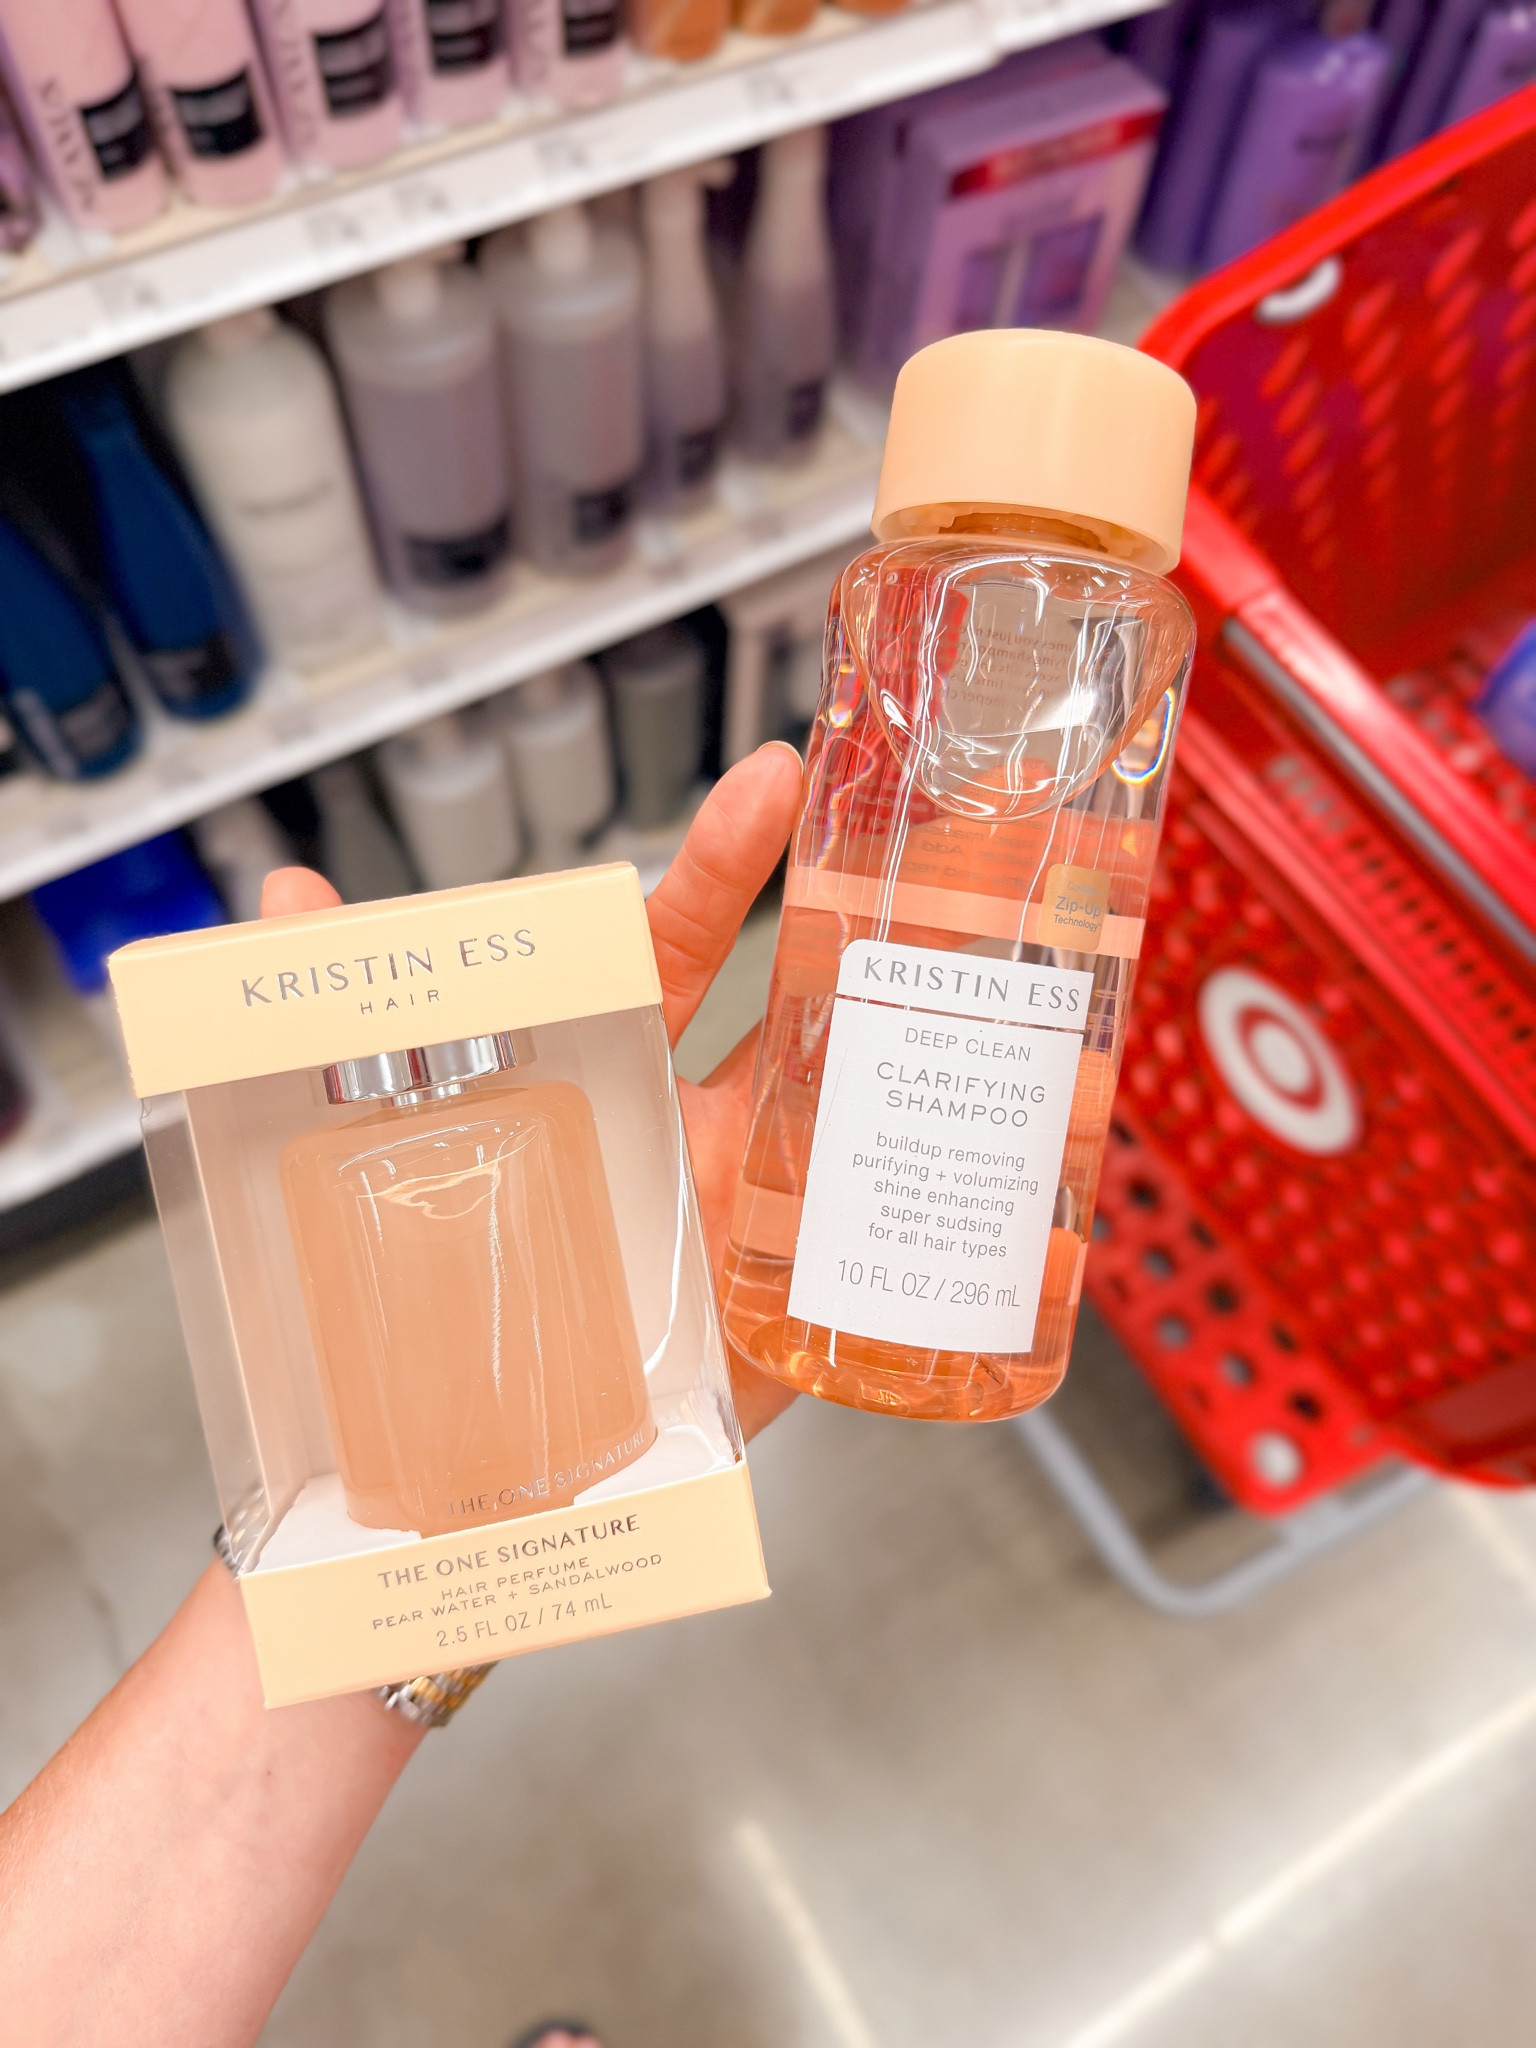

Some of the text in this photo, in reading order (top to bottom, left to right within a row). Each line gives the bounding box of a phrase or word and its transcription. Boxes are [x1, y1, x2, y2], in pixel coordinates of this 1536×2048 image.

[1055, 895, 1101, 920] Zip-Up
[240, 928, 536, 1008] KRISTIN ESS
[863, 956, 1081, 1012] KRISTIN ESS
[359, 989, 440, 1015] HAIR
[904, 1027, 1032, 1062] DEEP CLEAN
[876, 1061, 1046, 1104] CLARIFYING
[885, 1090, 1029, 1128] SHAMPOO
[875, 1131, 1026, 1172] buildup removing
[852, 1152, 1039, 1195] purifying + volumizing
[873, 1178, 1015, 1216] shine enhancing
[868, 1222, 1007, 1259] for all hair types
[880, 1204, 1002, 1238] super sudsing
[838, 1258, 1021, 1308] 10 FL OZ / 296 mL
[498, 1477, 549, 1506] ONE
[378, 1513, 641, 1589] THE ONE SIGNATURE
[372, 1553, 663, 1631] PEAR WATER + SANDALWOOD
[441, 1556, 590, 1600] HAIR PERFUME
[436, 1592, 613, 1648] 2.5 FL OZ / 74 mL
